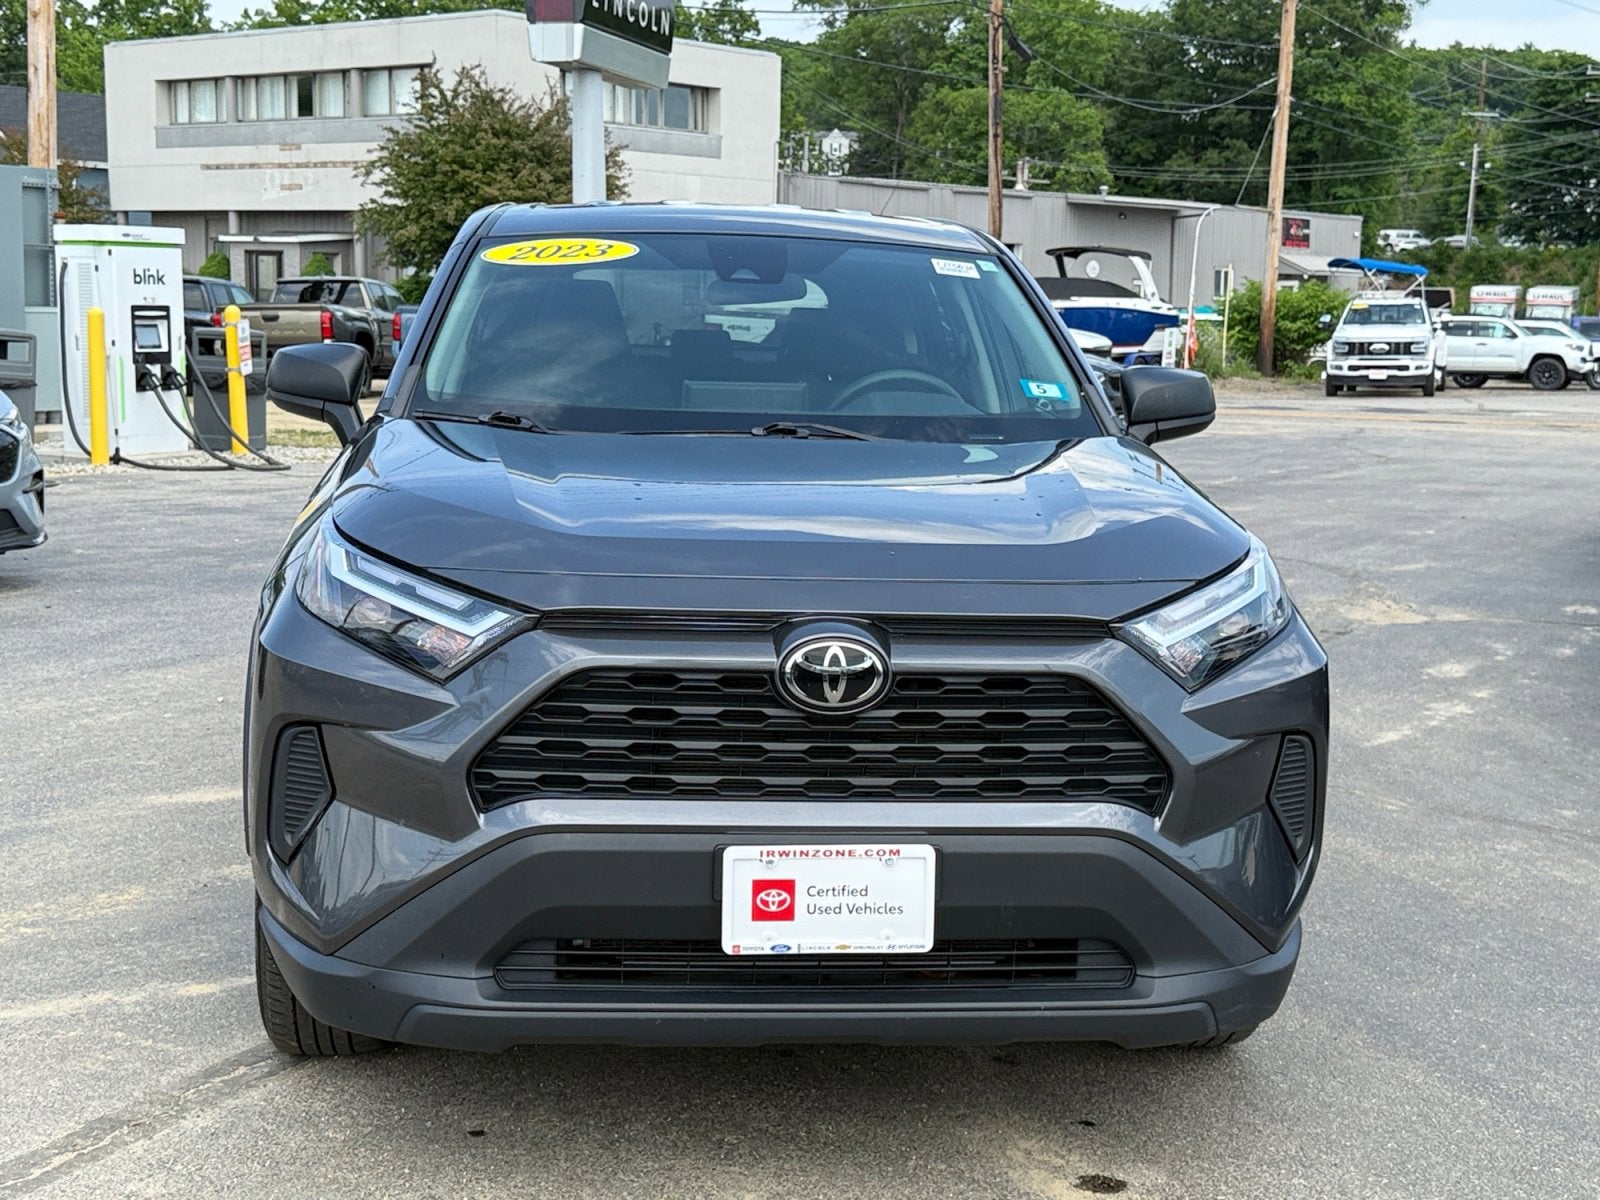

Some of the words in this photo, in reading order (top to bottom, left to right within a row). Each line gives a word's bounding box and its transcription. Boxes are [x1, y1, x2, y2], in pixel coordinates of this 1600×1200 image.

[508, 244, 614, 260] 2023
[133, 268, 166, 285] blink
[1036, 384, 1047, 394] 5
[759, 848, 902, 858] IRWINZONE.COM
[806, 885, 869, 897] Certified
[806, 903, 842, 915] Used
[846, 903, 904, 915] Vehicles
